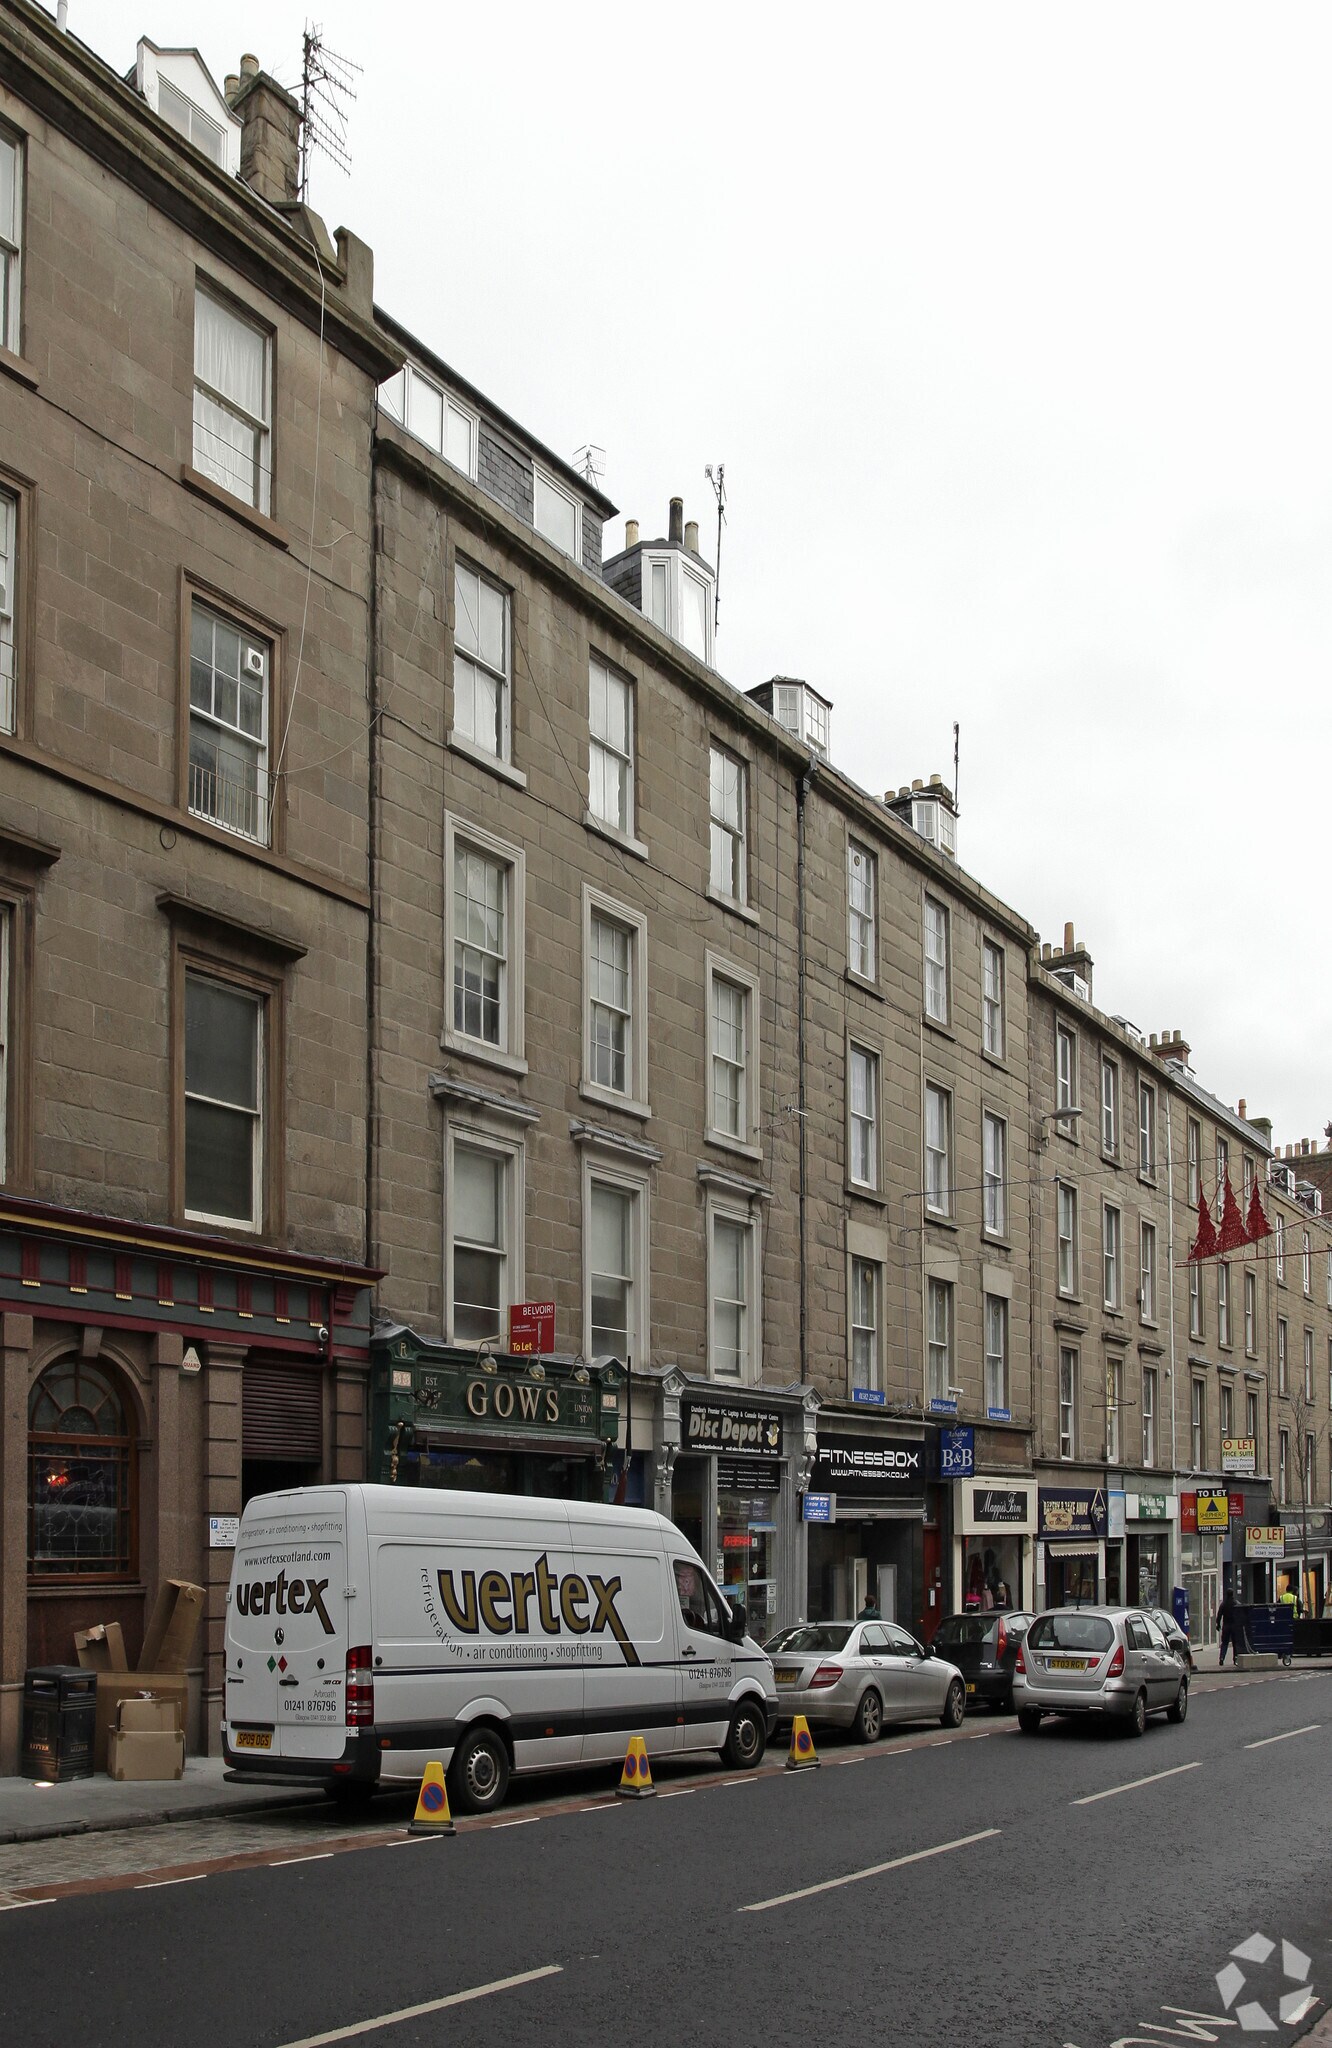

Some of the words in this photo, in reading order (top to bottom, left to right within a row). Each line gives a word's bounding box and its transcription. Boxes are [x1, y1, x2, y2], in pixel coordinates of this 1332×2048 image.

[512, 1342, 521, 1352] To
[521, 1341, 533, 1351] Let
[425, 1376, 438, 1387] EST
[466, 1381, 559, 1422] GOWS
[581, 1394, 587, 1403] 12
[574, 1404, 593, 1413] UNION
[580, 1415, 587, 1424] ST
[688, 1413, 719, 1439] Disc
[720, 1416, 763, 1448] Depot
[1237, 1440, 1253, 1450] LET
[819, 1448, 919, 1468] FITNESSBOX
[942, 1448, 973, 1468] B&B
[1212, 1489, 1227, 1497] LET
[1006, 1491, 1022, 1513] Farm
[268, 1527, 276, 1535] air
[275, 1523, 306, 1534] conditioning
[311, 1521, 343, 1533] shopfitting
[1246, 1528, 1262, 1540] TO
[1267, 1528, 1284, 1540] LET
[244, 1550, 331, 1566] www.vertexscotland.com
[236, 1568, 335, 1634] vertex
[420, 1567, 463, 1658] refrigeration
[473, 1645, 486, 1660] air
[489, 1644, 548, 1662] conditioning
[556, 1643, 603, 1661] shopfitting
[437, 1551, 641, 1667] vertex
[1051, 1659, 1069, 1669] ST03
[1070, 1660, 1085, 1669] RGY
[689, 1668, 707, 1680] 01241
[709, 1667, 732, 1679] 876796
[313, 1689, 337, 1698] Arbroath
[284, 1700, 305, 1711] 01241
[307, 1700, 337, 1711] 876796
[238, 1733, 255, 1745] SP09
[30, 1743, 50, 1752] LITTER
